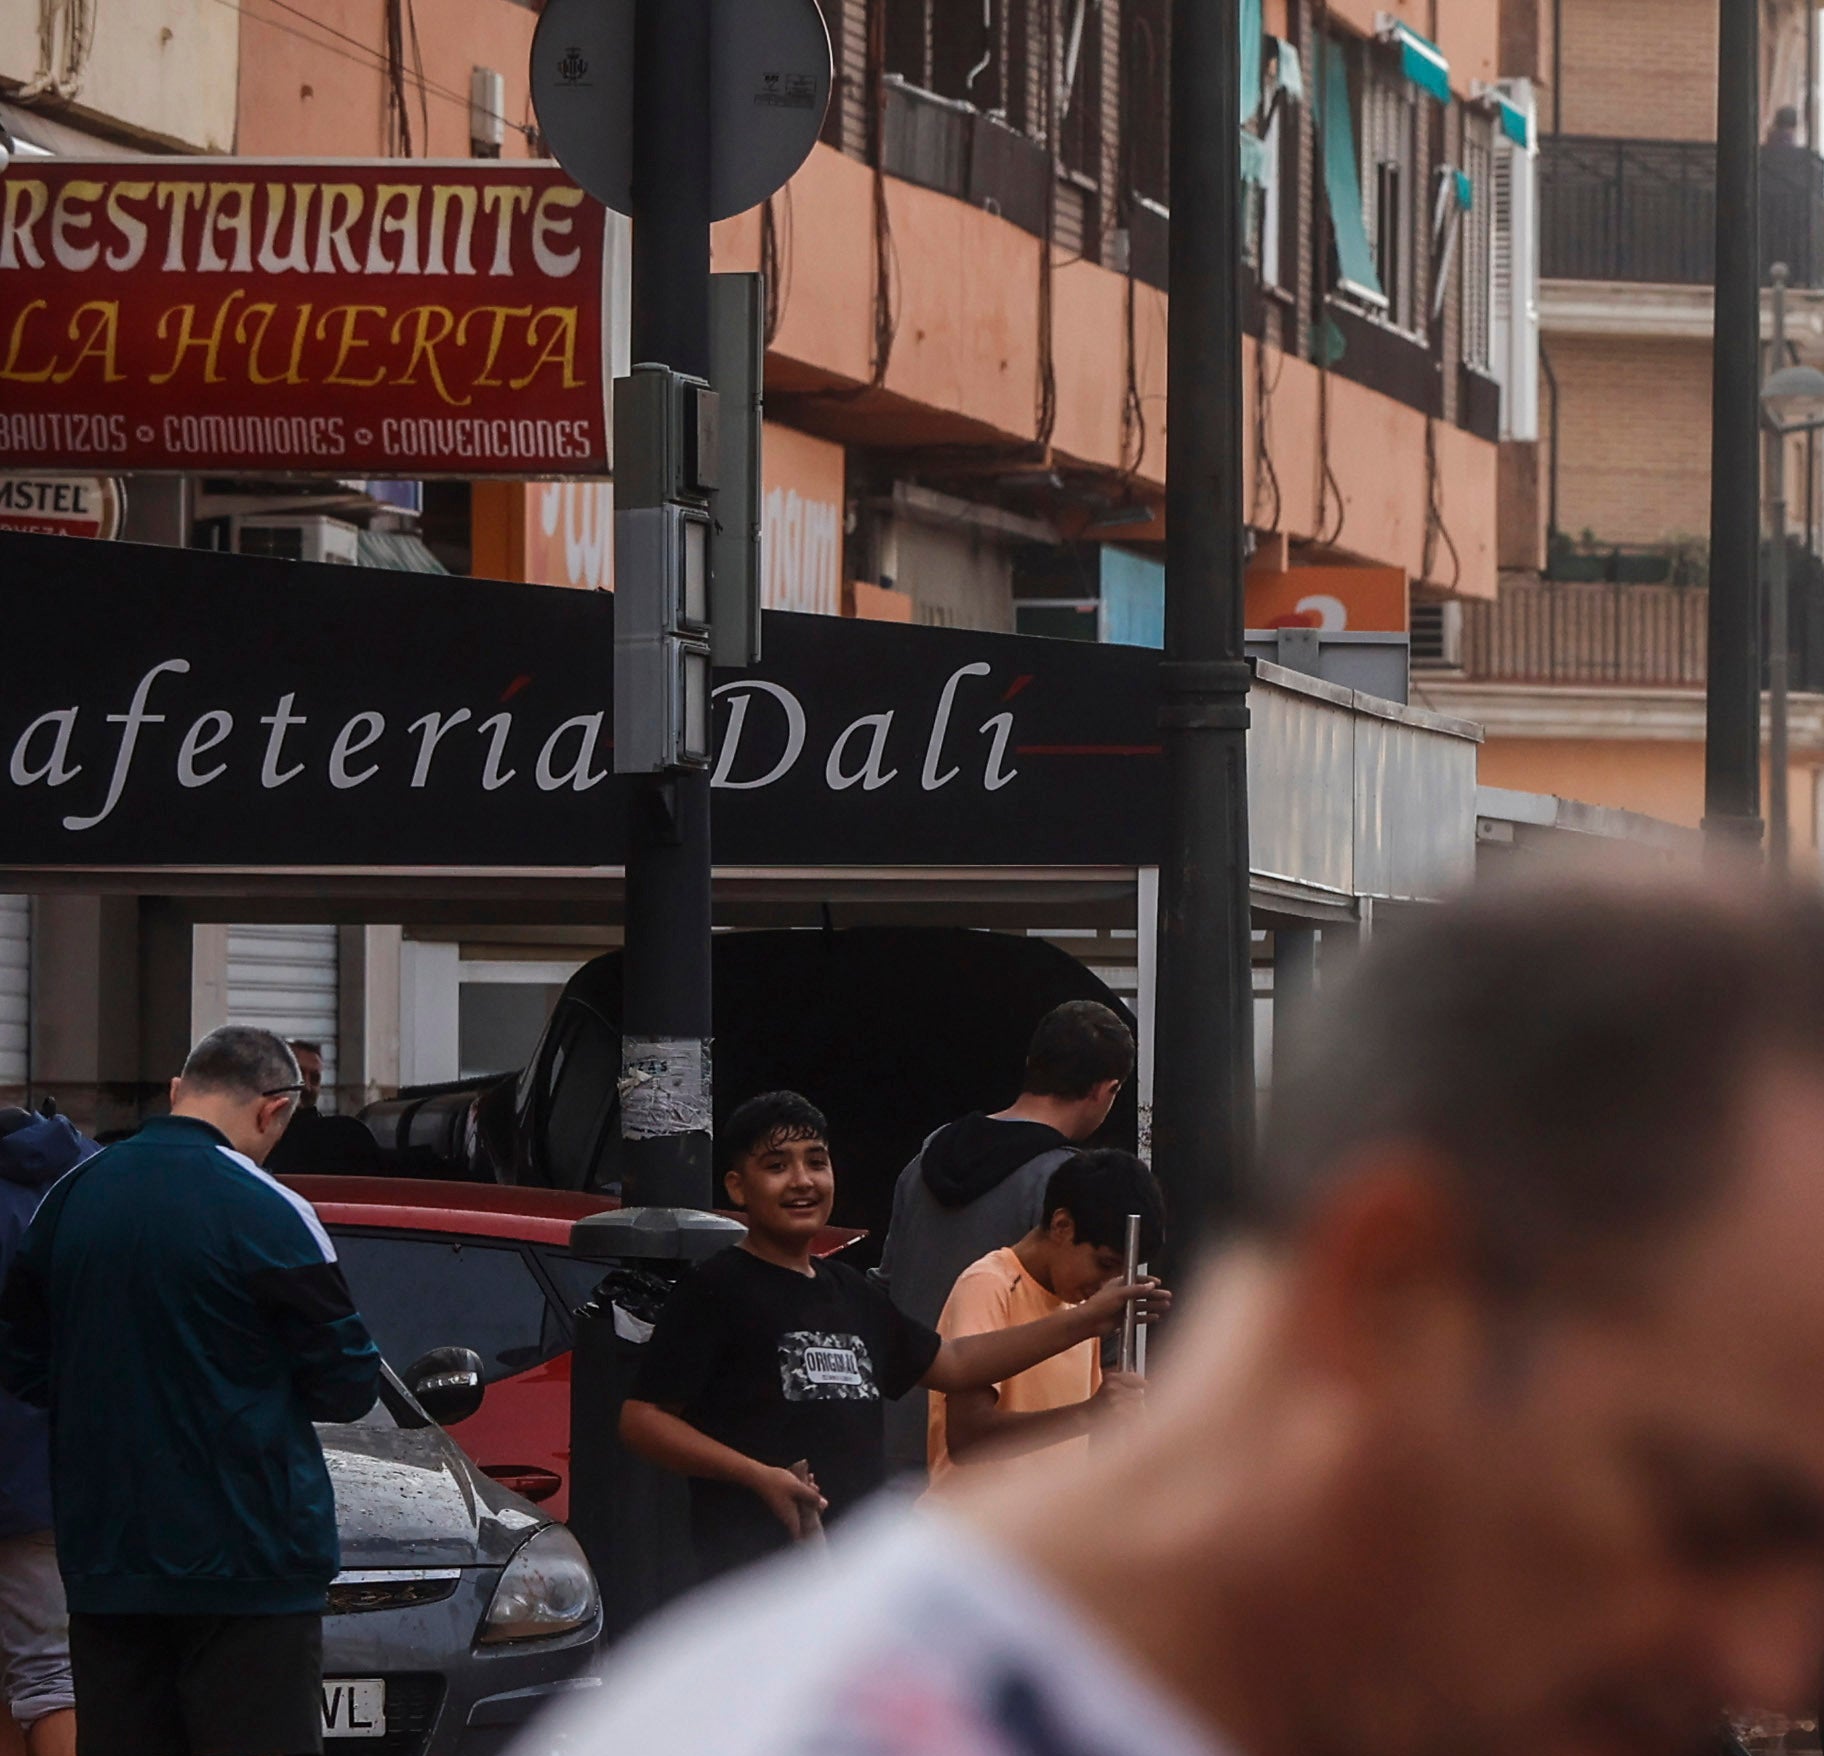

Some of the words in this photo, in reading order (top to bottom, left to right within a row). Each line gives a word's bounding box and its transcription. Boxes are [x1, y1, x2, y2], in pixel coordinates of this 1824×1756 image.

[0, 179, 585, 278] RESTAURANTE
[0, 299, 127, 384] LA
[149, 288, 586, 406] HUERTA
[0, 413, 127, 452] BAUTIZOS
[163, 415, 345, 456] COMUNIONES
[382, 418, 592, 459] CONVENCIONES
[710, 662, 1036, 791] Dalí
